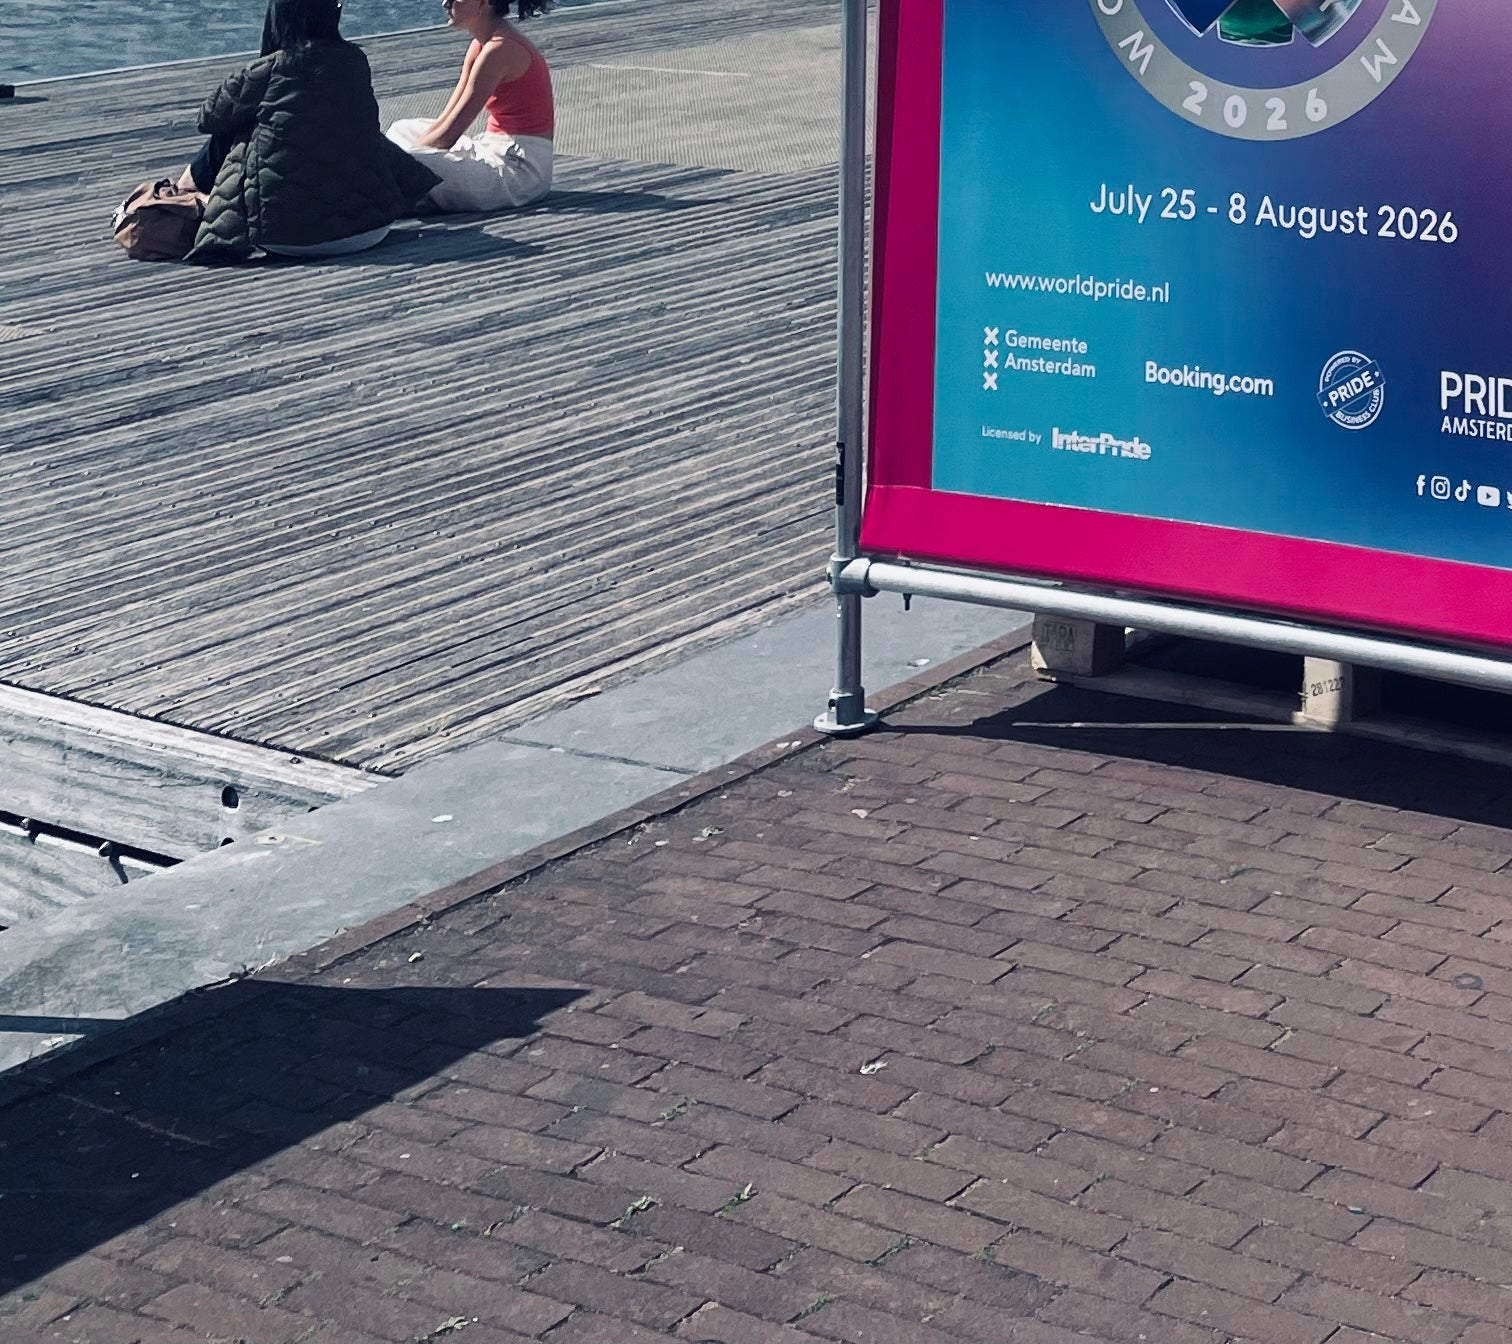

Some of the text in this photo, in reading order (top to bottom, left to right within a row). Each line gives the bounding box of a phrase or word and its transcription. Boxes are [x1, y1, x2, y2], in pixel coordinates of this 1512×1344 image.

[1182, 80, 1328, 131] 2026
[1090, 181, 1153, 225] July
[1160, 187, 1198, 220] 25
[1228, 193, 1247, 225] 8
[1254, 195, 1368, 239] August
[1377, 206, 1459, 244] 2026
[984, 269, 1170, 304] www.worldpride.nl
[1005, 330, 1088, 354] Gemeente
[1005, 352, 1097, 379] Amsterdam
[1145, 360, 1274, 397] Booking.com
[1328, 370, 1375, 407] PRIDE
[981, 425, 1042, 445] Licensed by
[1052, 426, 1152, 461] InterPride
